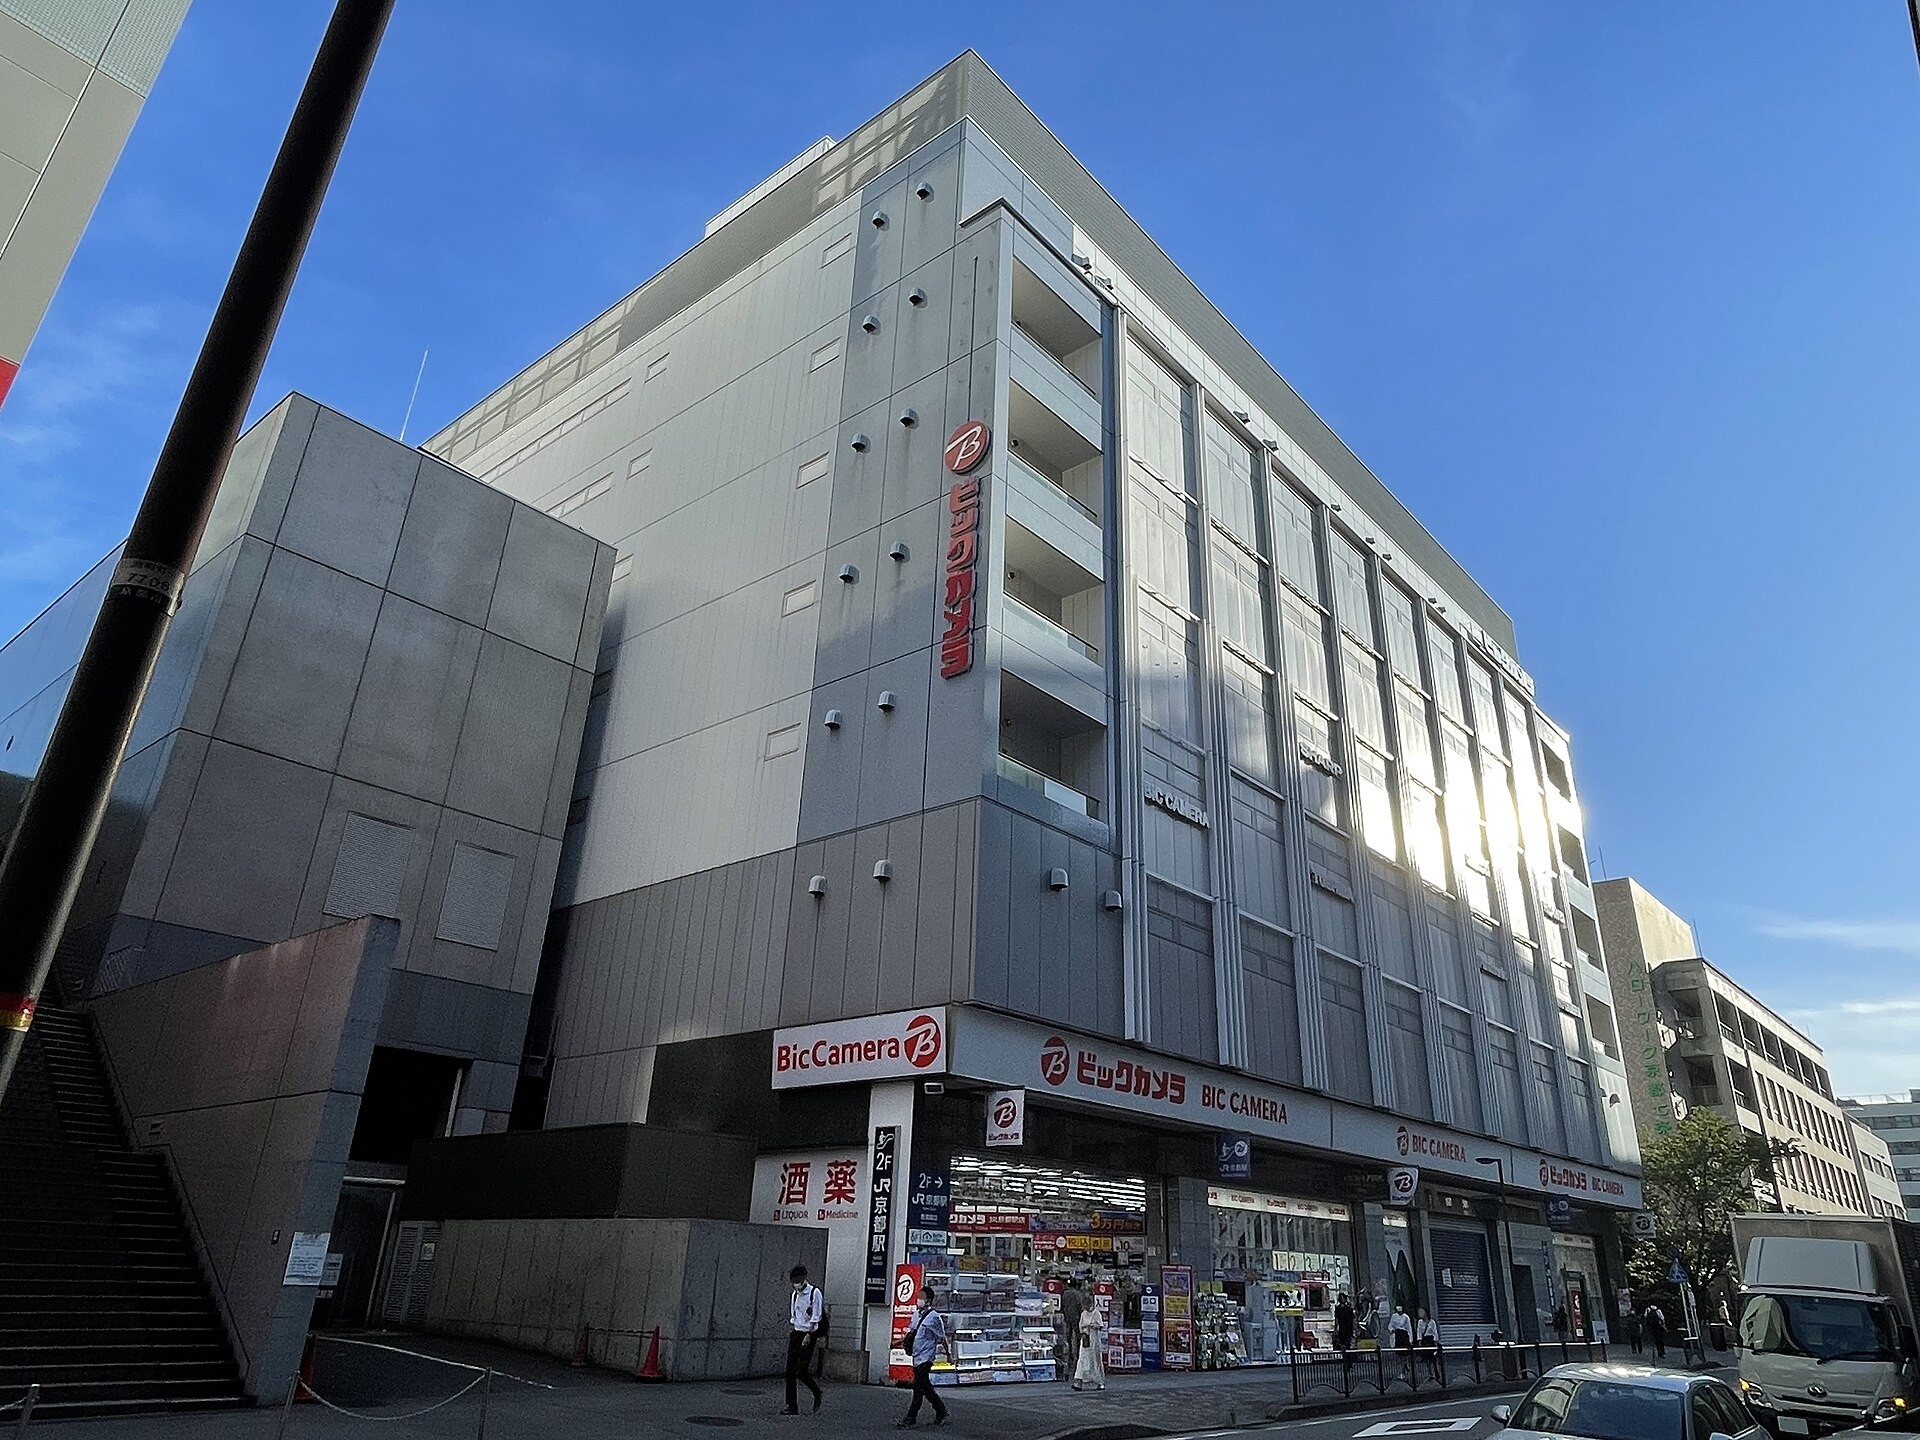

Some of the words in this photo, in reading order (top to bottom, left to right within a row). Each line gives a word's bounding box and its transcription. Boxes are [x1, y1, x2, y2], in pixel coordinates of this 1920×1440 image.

[941, 475, 979, 680] ビックカメラ
[1145, 784, 1164, 805] BIC
[1165, 792, 1209, 829] CAMERA
[777, 1037, 900, 1071] BicCamera
[1077, 1051, 1186, 1105] ビックカメラ
[1202, 1084, 1225, 1110] BIC
[1230, 1091, 1288, 1125] CAMERA
[876, 1152, 892, 1170] 2F
[1413, 1134, 1428, 1155] BIC
[1430, 1139, 1466, 1163] CAMERA
[778, 1161, 811, 1205] 酒
[823, 1160, 857, 1205] 薬
[919, 1173, 931, 1188] 2F
[782, 1210, 809, 1221] LIQUOR
[826, 1209, 858, 1219] Medicine
[873, 1178, 891, 1252] JR京都駅
